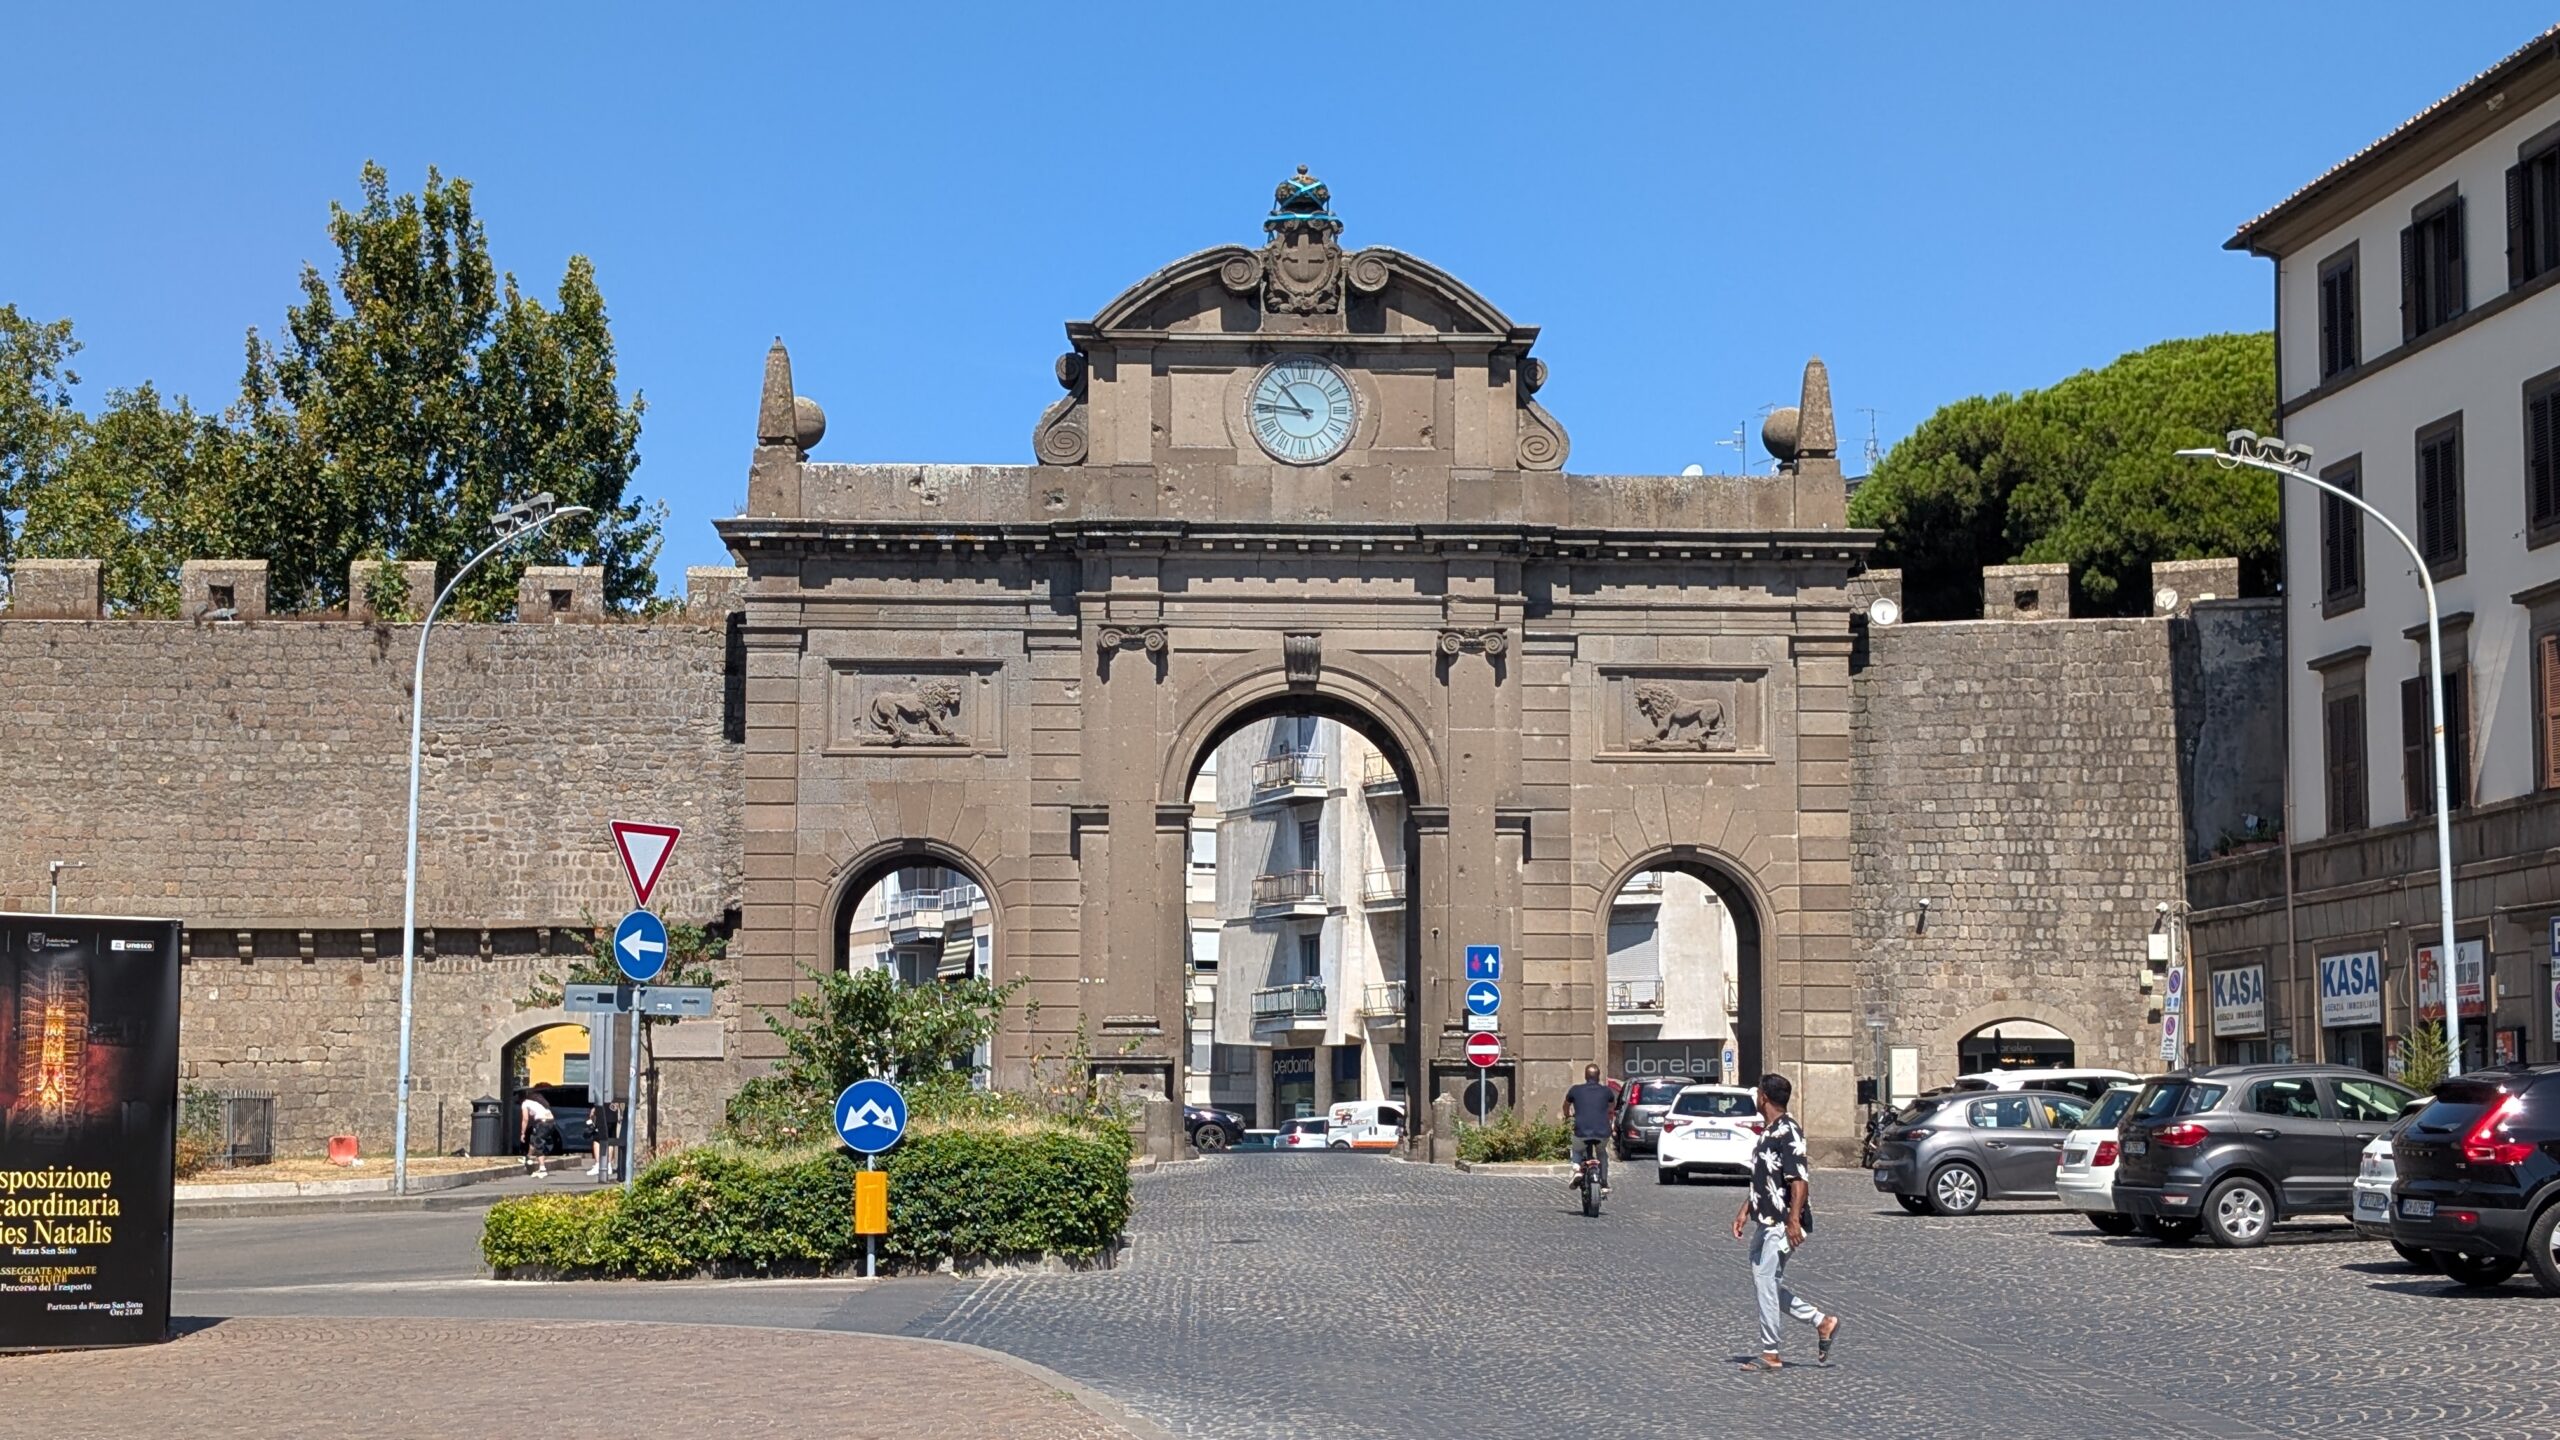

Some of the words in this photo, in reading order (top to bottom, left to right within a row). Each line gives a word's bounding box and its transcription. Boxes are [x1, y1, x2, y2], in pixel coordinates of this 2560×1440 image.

[1298, 366, 1308, 380] XII
[1333, 406, 1347, 414] III
[2322, 956, 2378, 998] KASA
[2214, 969, 2263, 1007] KASA
[32, 1219, 112, 1244] Natalis
[12, 1247, 39, 1255] Piazza
[40, 1246, 56, 1255] San
[57, 1247, 77, 1255] Sisto
[0, 1267, 52, 1276] SSEGGIATE
[55, 1266, 97, 1275] NARRATE
[53, 1284, 92, 1293] Trasporto
[89, 1302, 110, 1310] Piazza
